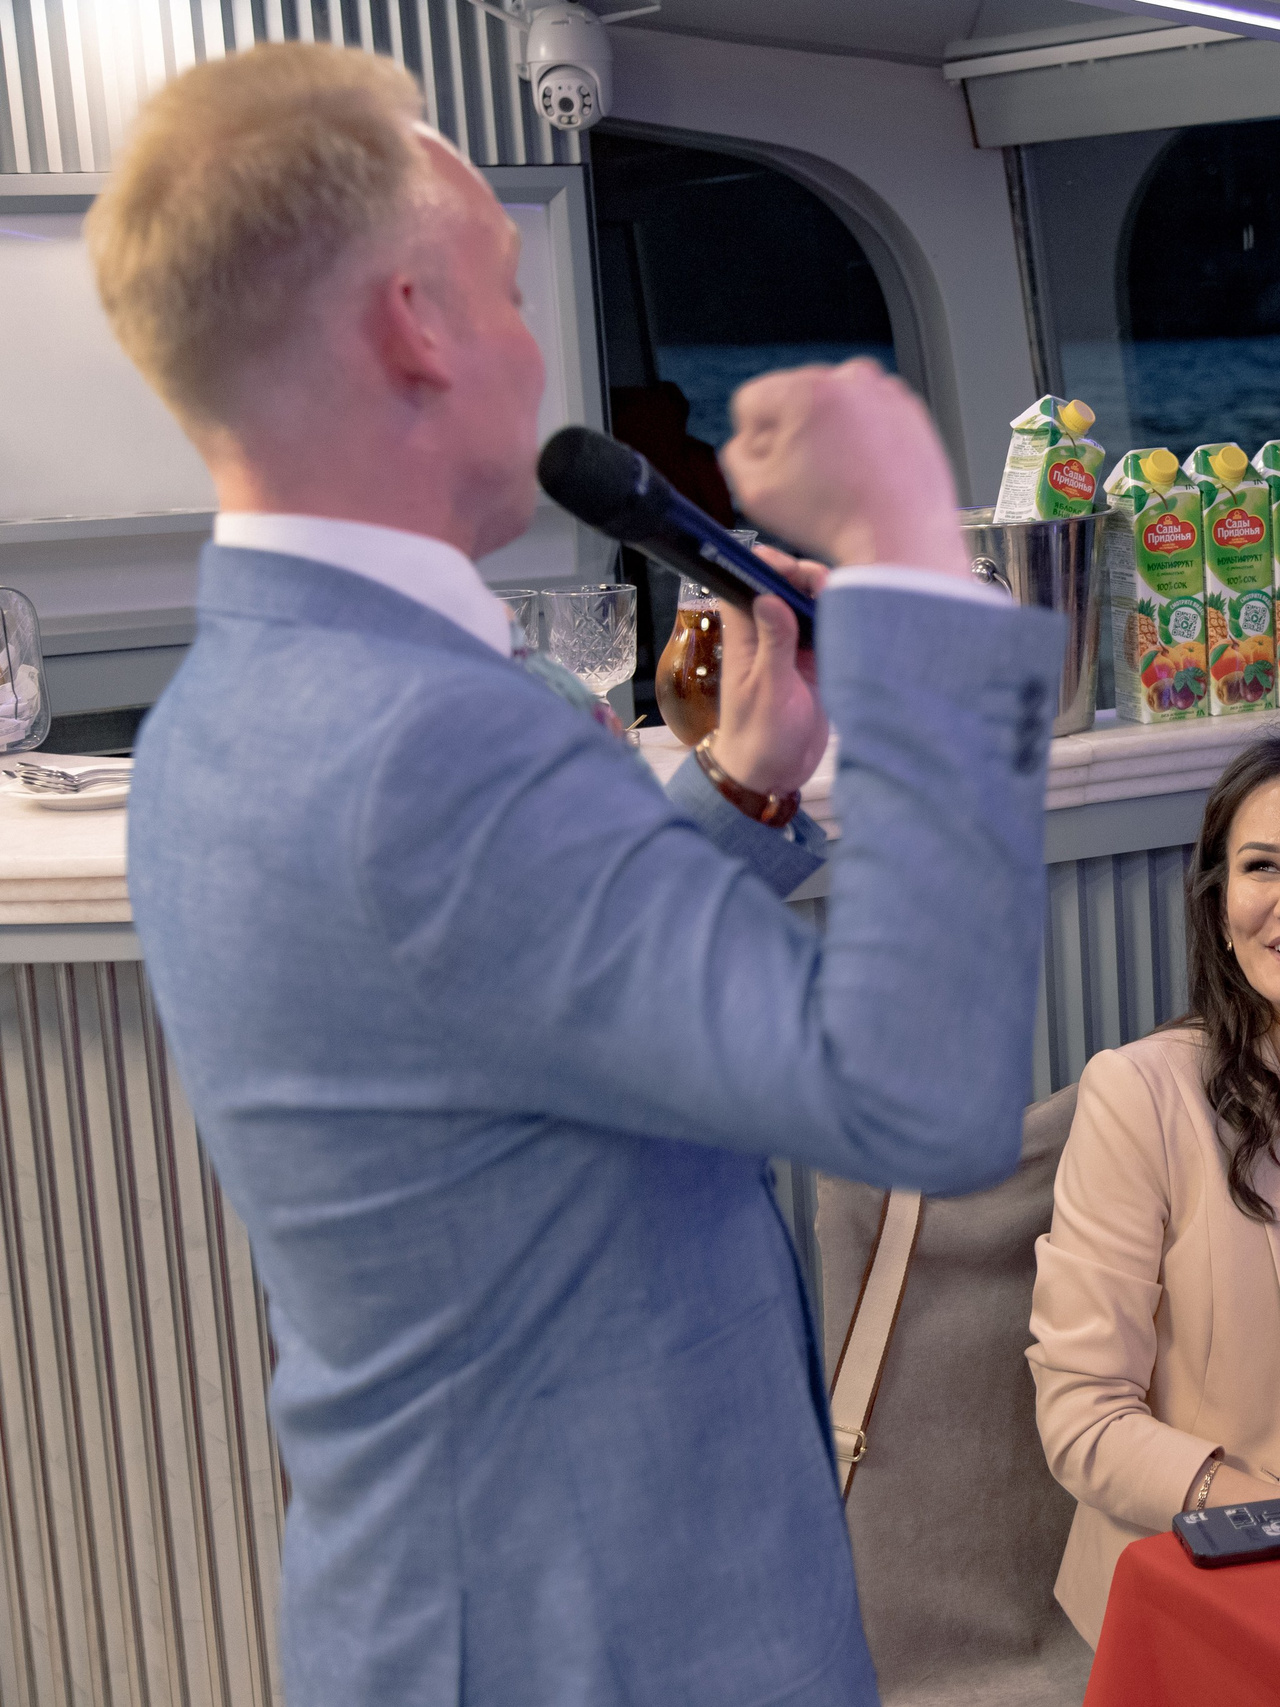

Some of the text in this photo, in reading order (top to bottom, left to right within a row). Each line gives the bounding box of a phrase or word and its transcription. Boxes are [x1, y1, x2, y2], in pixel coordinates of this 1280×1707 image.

[1063, 466, 1086, 482] Сады
[1053, 470, 1093, 493] Придонья
[1156, 524, 1181, 534] Сады
[1225, 518, 1250, 528] Сады
[1147, 532, 1192, 546] Придонья
[1217, 527, 1260, 539] Придонья
